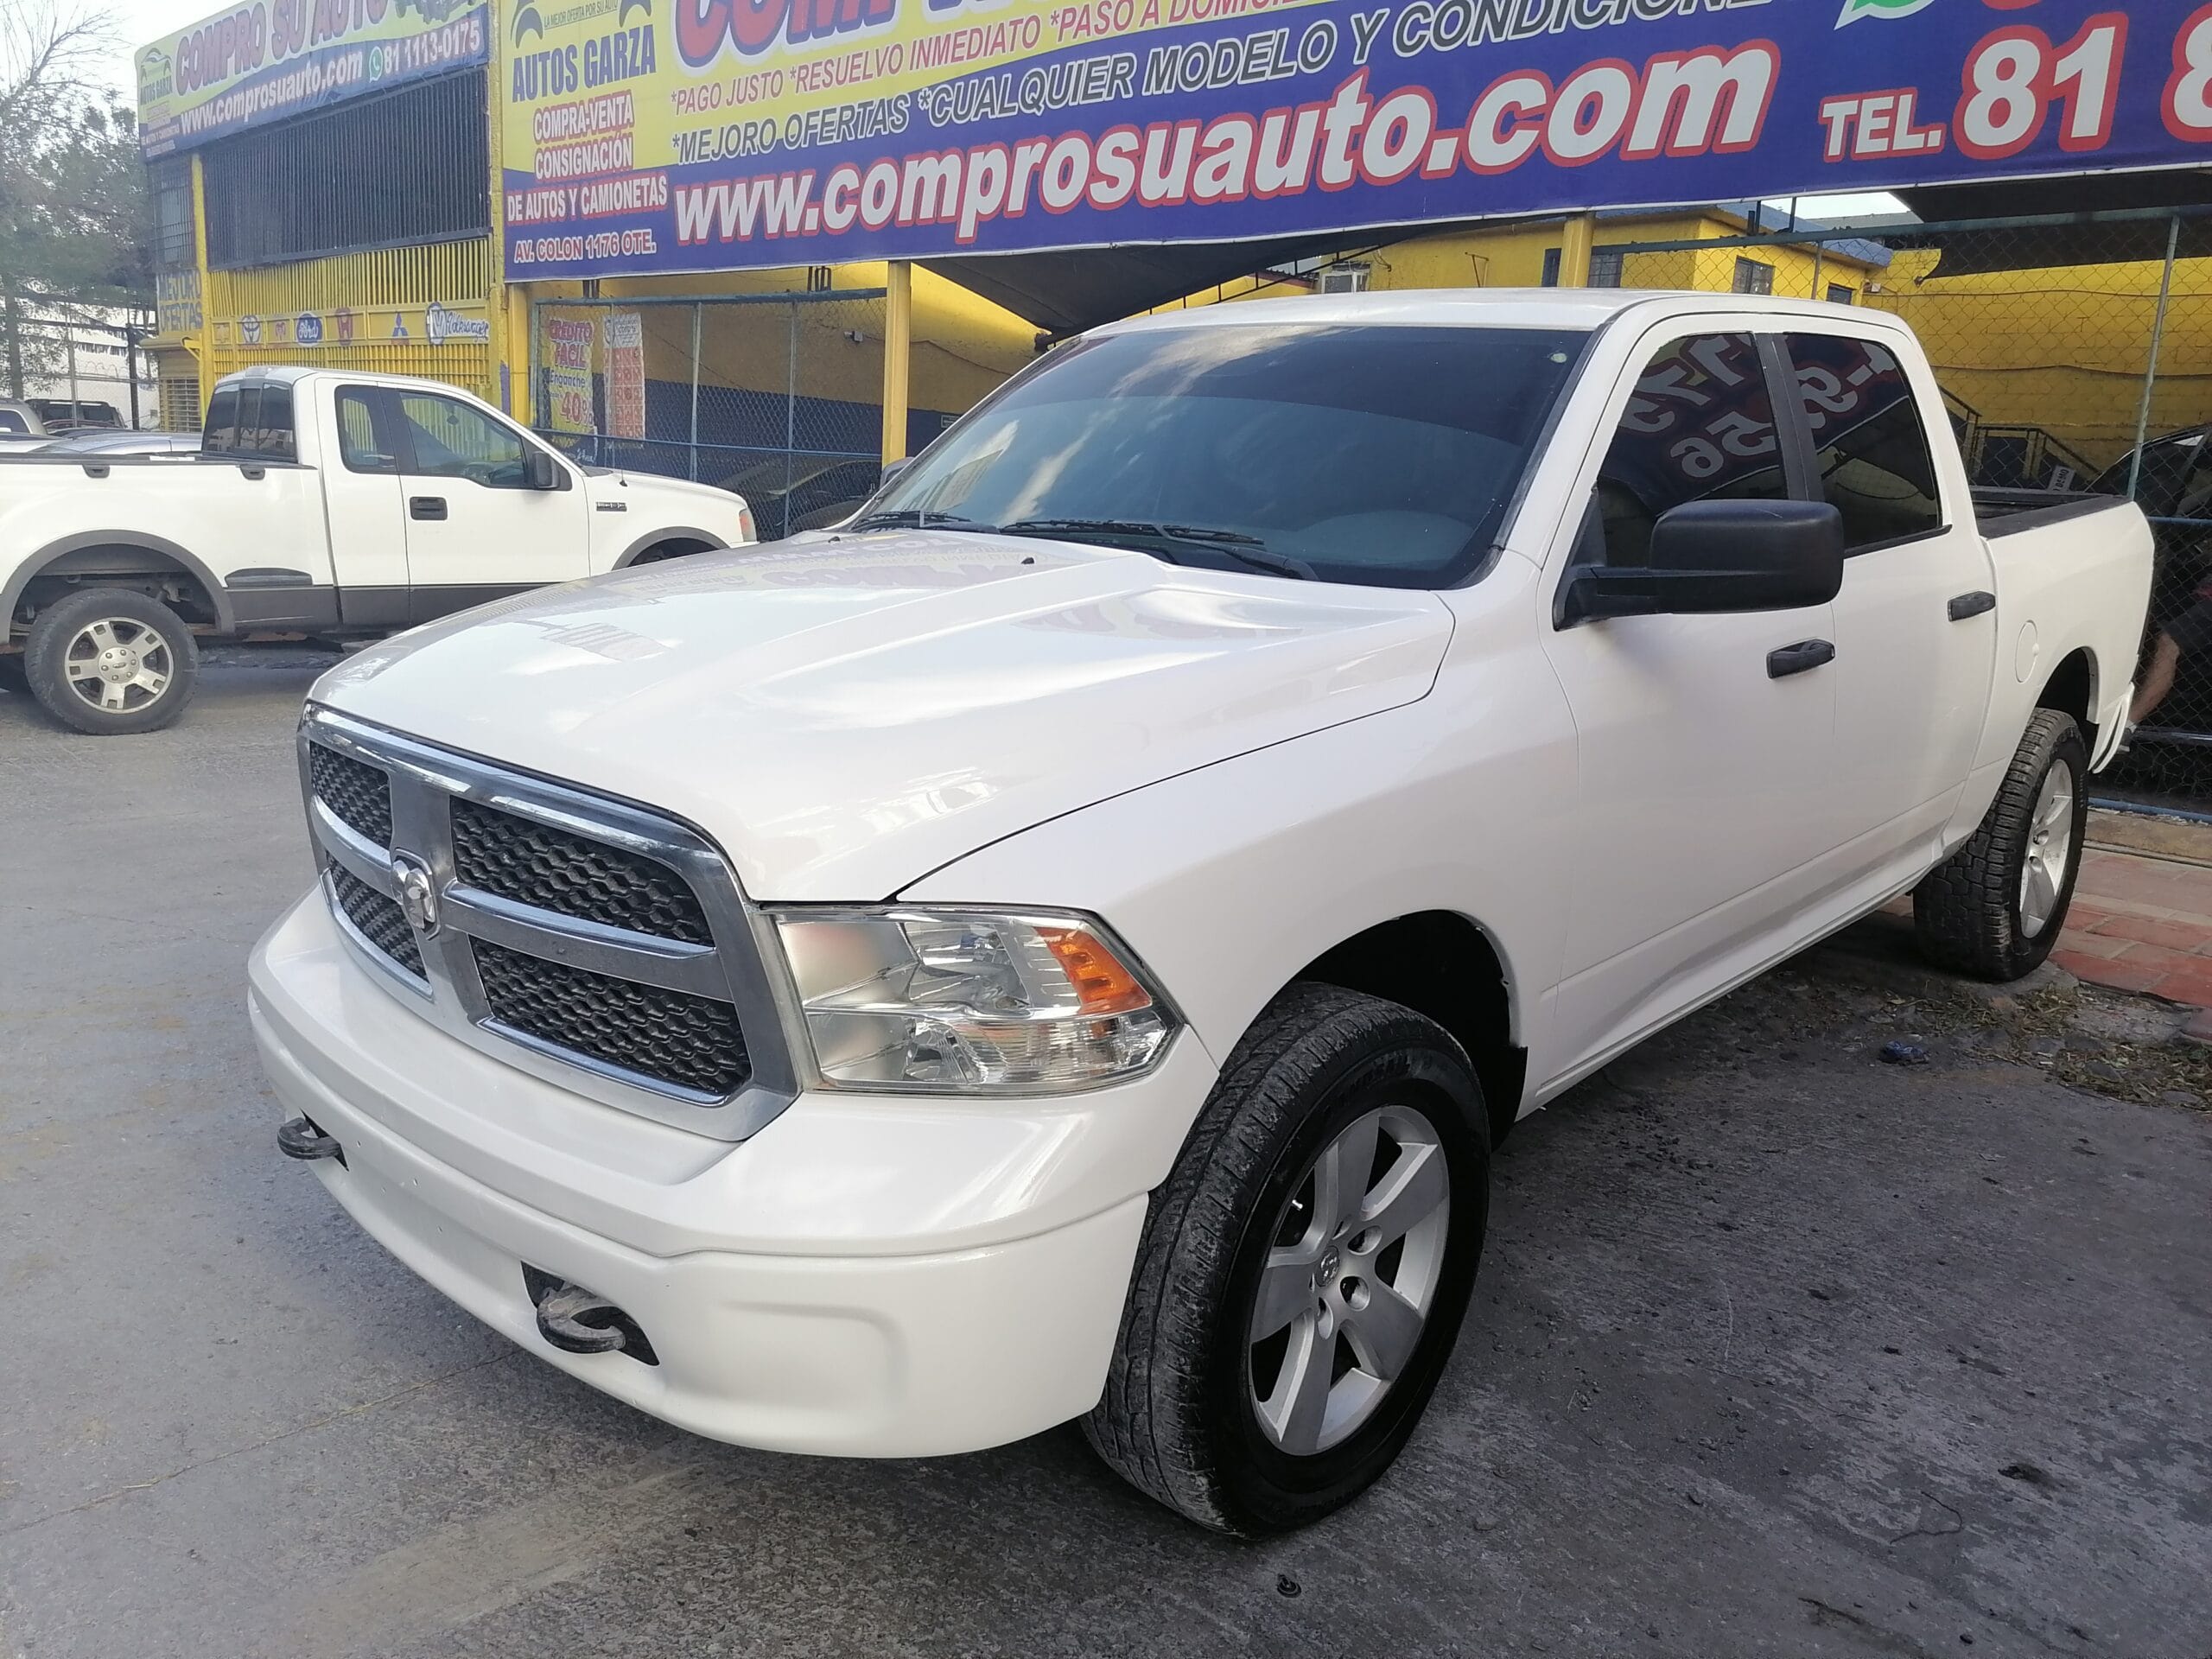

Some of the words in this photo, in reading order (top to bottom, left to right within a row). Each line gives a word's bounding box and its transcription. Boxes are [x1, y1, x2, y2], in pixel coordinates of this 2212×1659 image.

[585, 3, 596, 17] POR
[176, 2, 266, 96] COMPRO
[271, 0, 307, 60] SU
[512, 43, 579, 103] AUTOS
[583, 23, 657, 89] GARZA
[726, 68, 784, 104] JUSTO
[909, 16, 1041, 72] INMEDIATO
[1139, 0, 1161, 29] A
[782, 93, 911, 150] OFERTAS
[1142, 22, 1338, 95] MODELO
[1351, 7, 1389, 65] Y
[533, 92, 634, 143] COMPRA-VENTA
[1820, 90, 1944, 159] TEL.
[1957, 17, 2125, 155] 81
[535, 134, 632, 181] CONSIGNACIÓN
[675, 43, 1777, 243] www.comprosuauto.com
[506, 194, 524, 222] DE
[525, 188, 566, 220] AUTOS
[568, 188, 578, 217] Y
[581, 175, 668, 216] CAMIONETAS
[514, 239, 535, 264] AV.
[537, 236, 583, 262] COLON
[585, 232, 620, 258] 1176
[621, 228, 657, 256] OTE.
[549, 371, 586, 388] Enganche
